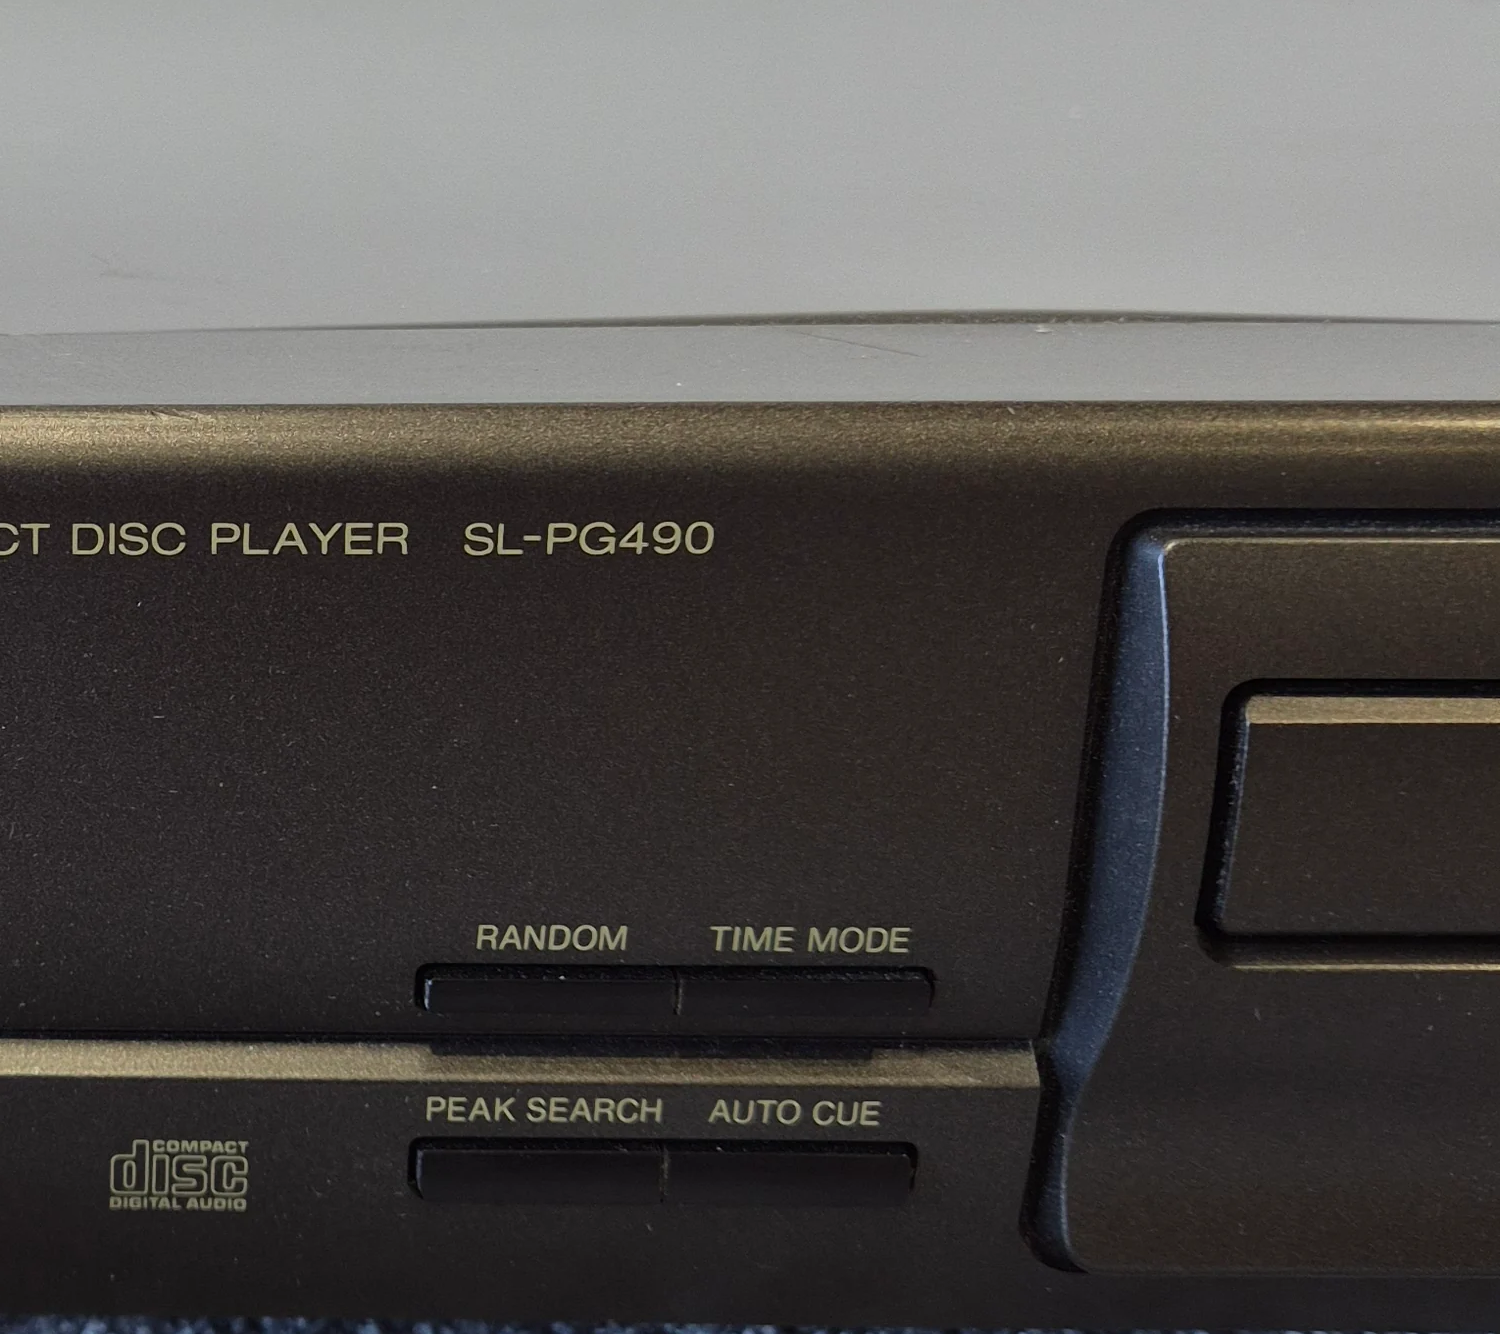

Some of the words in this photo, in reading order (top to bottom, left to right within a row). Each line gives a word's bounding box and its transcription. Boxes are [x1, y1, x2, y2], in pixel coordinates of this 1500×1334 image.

[71, 522, 186, 556] DISC
[210, 522, 409, 555] PLAYER
[463, 521, 715, 556] SL-PG490
[476, 924, 629, 951] RANDOM
[709, 925, 796, 953] TIME
[807, 926, 912, 954] MODE
[426, 1096, 516, 1122] PEAK
[526, 1096, 663, 1124] SEARCH
[708, 1099, 802, 1125] AUTO
[812, 1100, 882, 1127] CUE
[152, 1139, 249, 1153] COMPACT
[109, 1196, 181, 1209] DIGITAL
[186, 1197, 248, 1211] AUDIO
